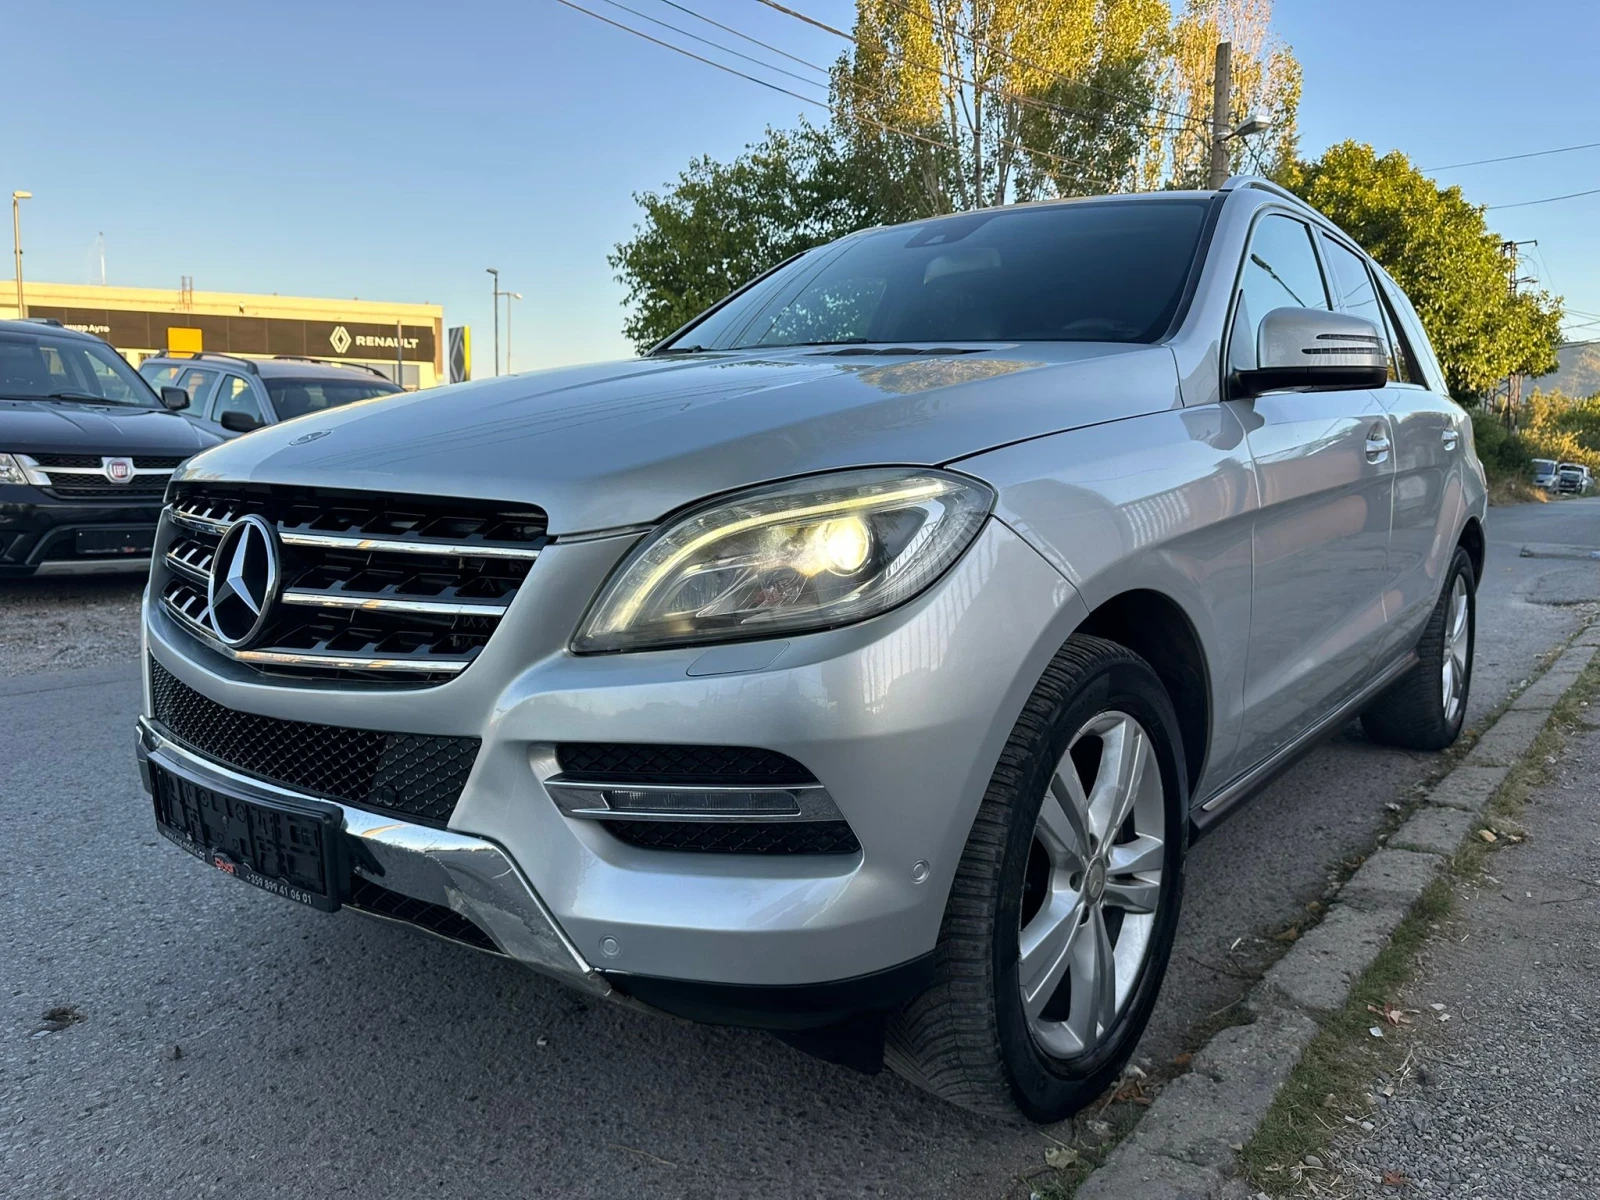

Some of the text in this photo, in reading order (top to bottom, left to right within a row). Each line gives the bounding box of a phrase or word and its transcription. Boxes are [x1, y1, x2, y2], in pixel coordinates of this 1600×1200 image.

[88, 324, 110, 334] Ауто
[355, 335, 419, 349] RENAULT
[279, 885, 288, 897] 41
[290, 889, 301, 901] 06
[302, 893, 312, 905] 01
